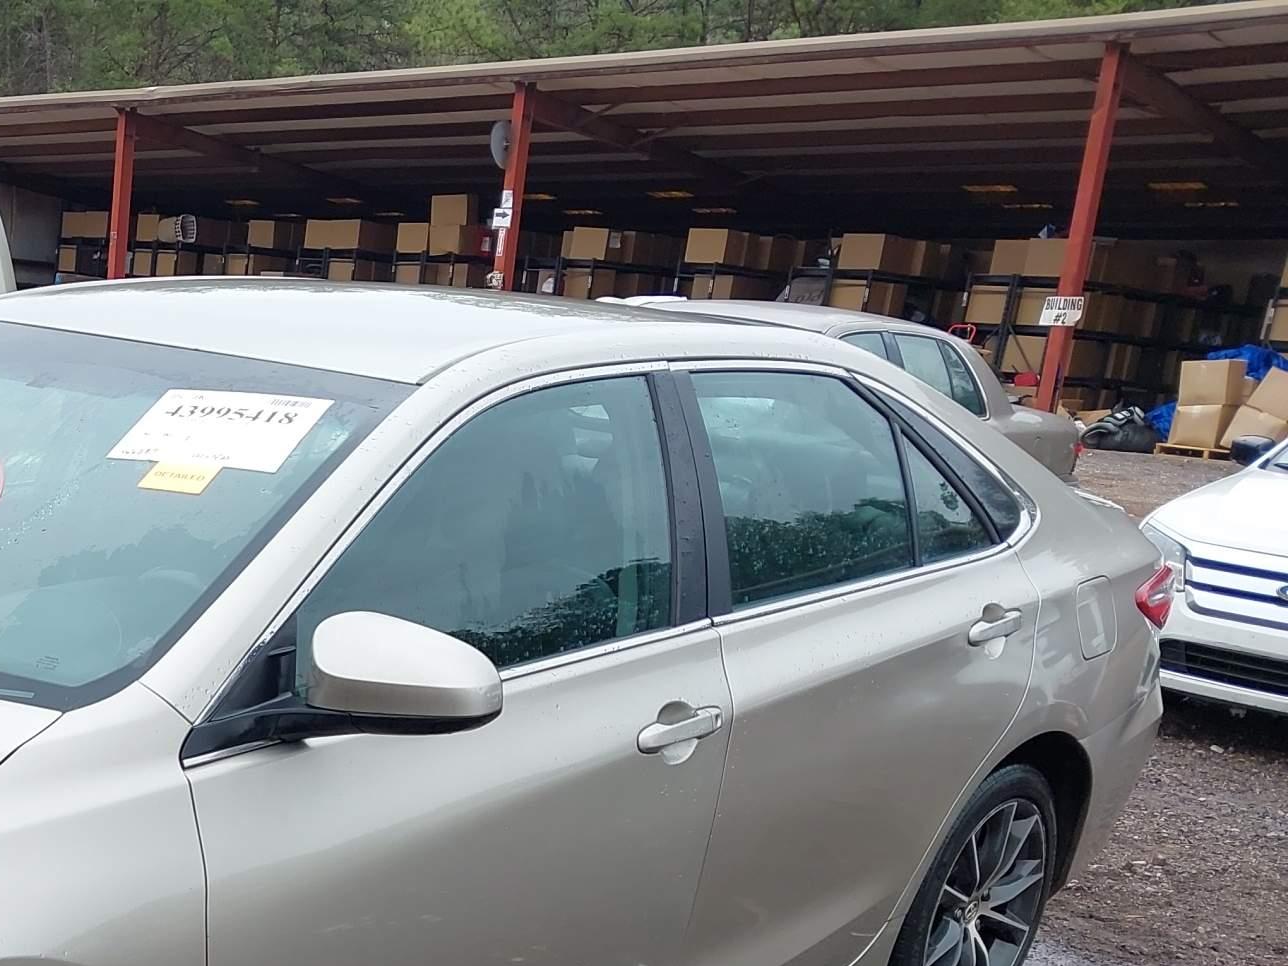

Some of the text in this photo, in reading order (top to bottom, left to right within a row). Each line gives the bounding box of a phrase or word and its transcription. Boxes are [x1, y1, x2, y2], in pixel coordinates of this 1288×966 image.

[1045, 298, 1083, 310] BUILDING
[1053, 312, 1067, 324] #2
[165, 405, 299, 425] 43995418
[153, 471, 205, 482] DETAILED
